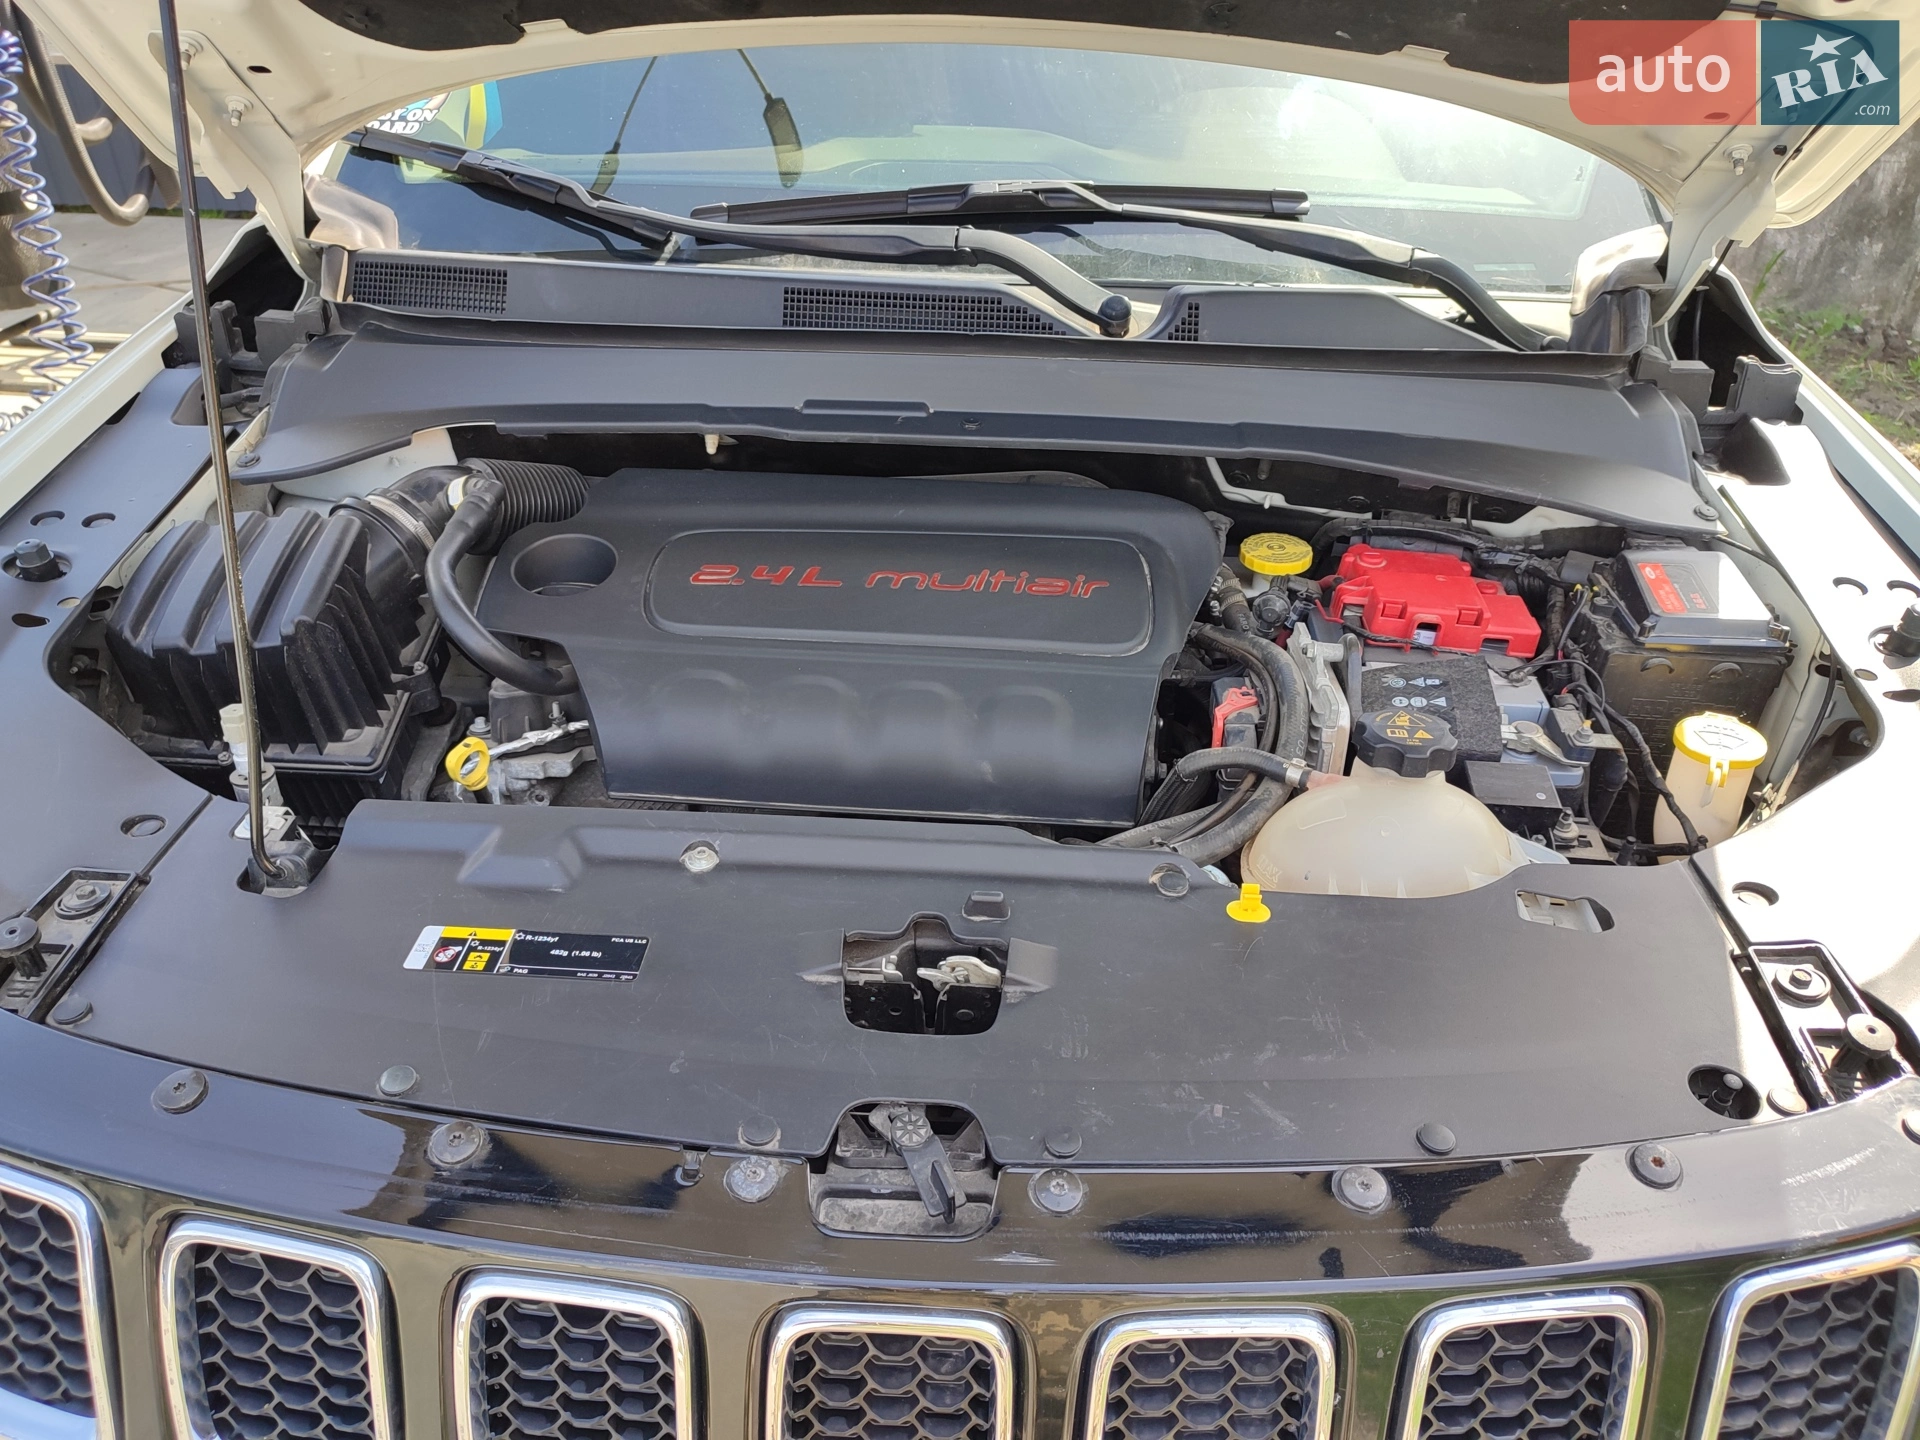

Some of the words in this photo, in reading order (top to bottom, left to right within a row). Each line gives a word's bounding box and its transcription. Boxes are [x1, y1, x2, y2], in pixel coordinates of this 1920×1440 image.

[407, 108, 439, 122] ON
[689, 564, 843, 588] 2.4L
[864, 569, 1110, 598] multiair
[525, 934, 560, 943] R-1234yf
